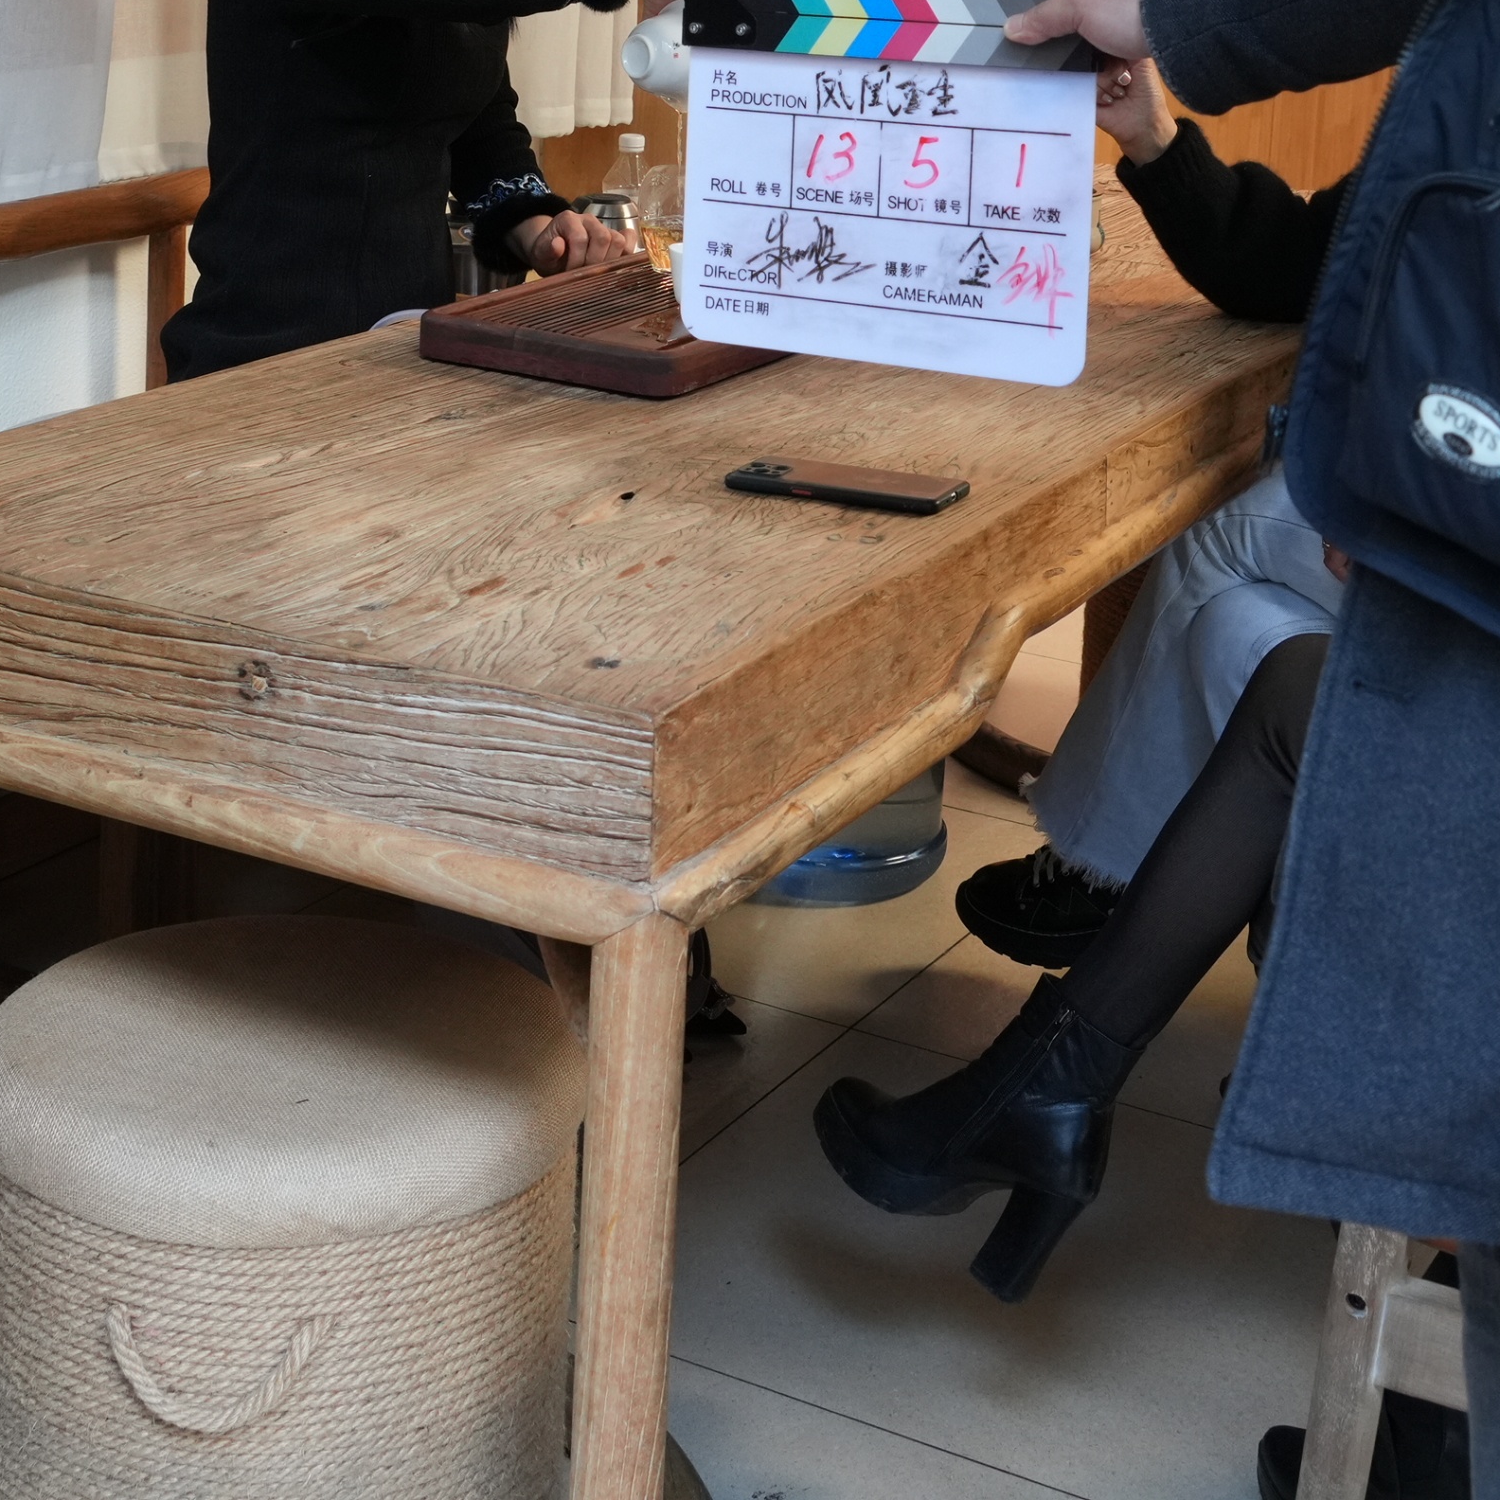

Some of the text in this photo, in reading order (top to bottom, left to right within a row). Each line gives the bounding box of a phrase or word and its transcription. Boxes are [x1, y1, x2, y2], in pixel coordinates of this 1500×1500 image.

[712, 69, 737, 86] 片名
[711, 88, 807, 110] PRODUCTION
[806, 131, 857, 184] 13
[903, 136, 939, 189] 5
[1015, 143, 1026, 188] 1
[710, 178, 782, 198] ROLL 卷号
[796, 187, 875, 207] SCENE 场号
[888, 195, 962, 215] SHOT 镜号
[983, 204, 1061, 224] TAKE 次数
[706, 241, 733, 258] 导演
[704, 263, 779, 285] DIRECTOR
[882, 284, 984, 309] CAMERAMAN
